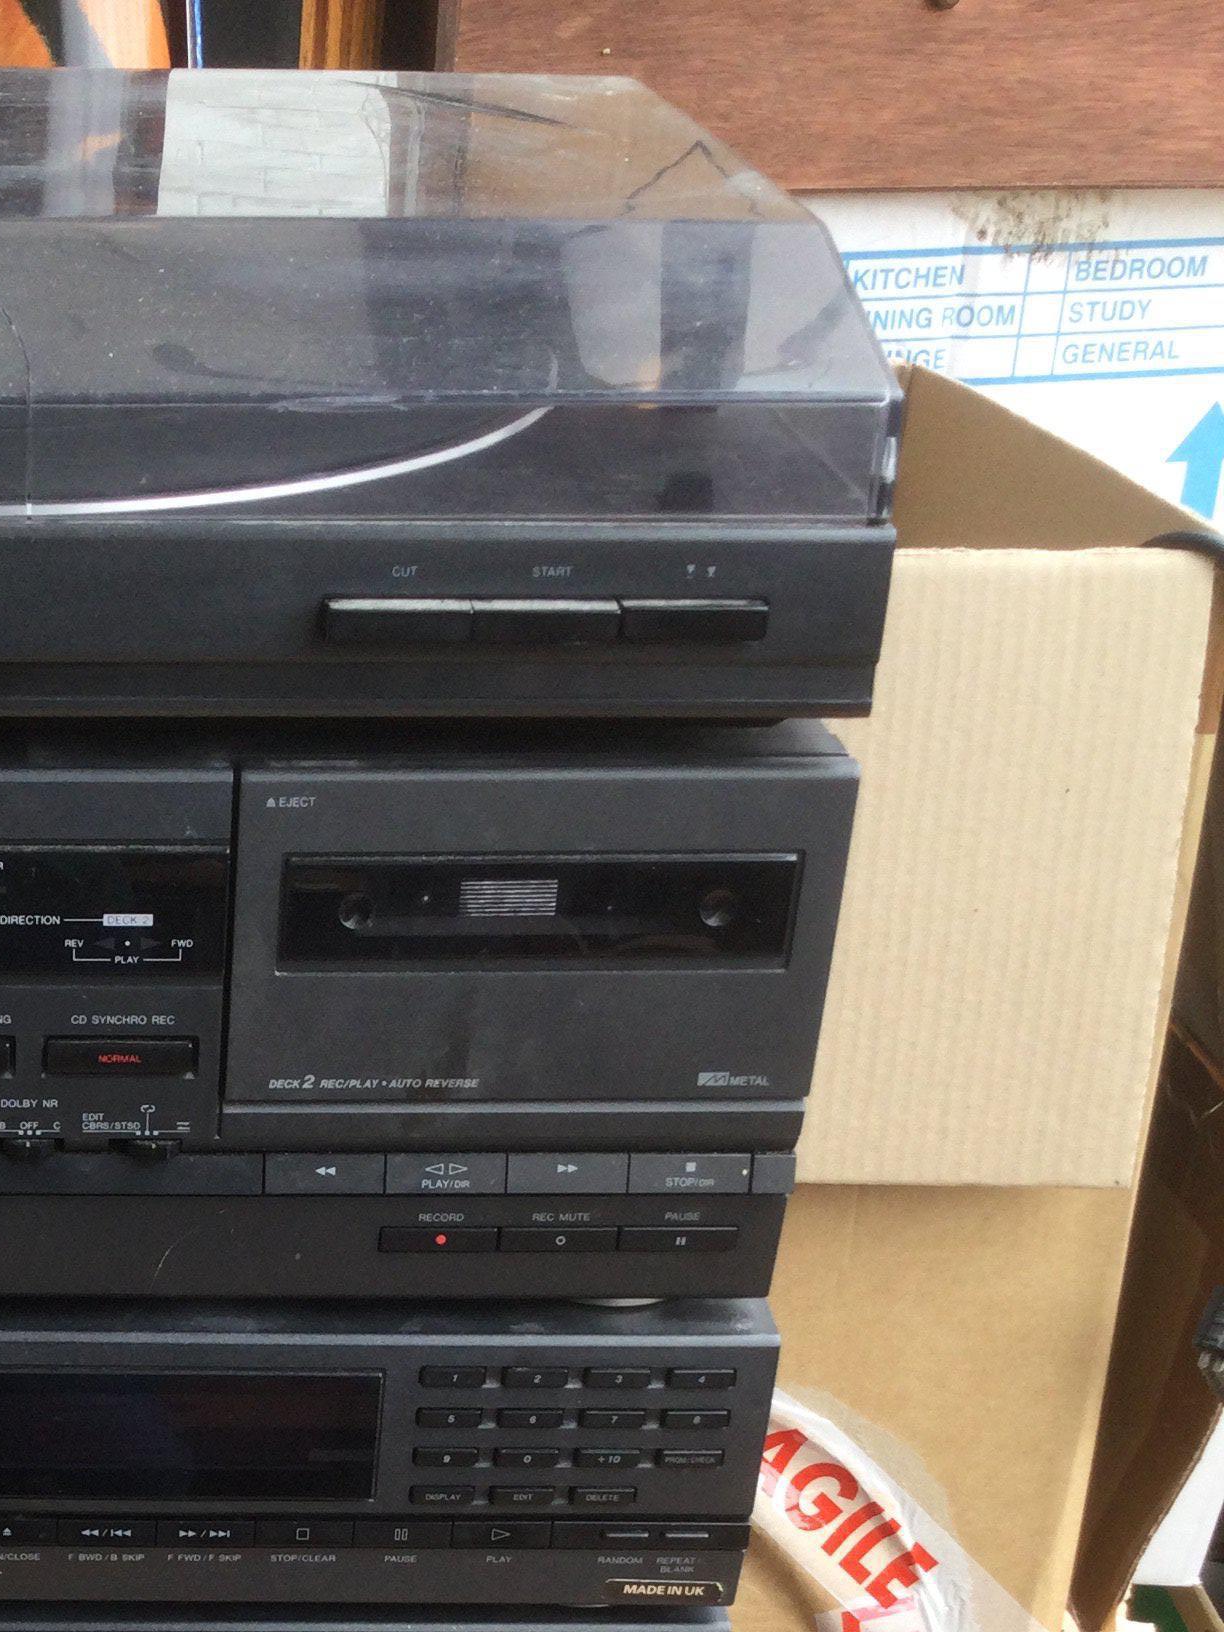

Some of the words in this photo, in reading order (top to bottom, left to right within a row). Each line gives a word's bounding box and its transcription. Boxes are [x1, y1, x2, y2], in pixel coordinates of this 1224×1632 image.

[1075, 254, 1209, 283] BEDROOM
[853, 264, 965, 291] KITCHEN
[941, 305, 1016, 329] ROOM
[1068, 299, 1152, 324] STUDY
[1062, 340, 1181, 365] GENERAL
[532, 565, 573, 578] START
[278, 796, 316, 808] EJECT
[0, 915, 61, 925] DIRECTION
[64, 939, 84, 948] REV
[171, 939, 193, 948] FWD
[114, 955, 139, 965] PLAY
[70, 1015, 87, 1025] CD
[91, 1015, 147, 1025] SYNCHRO
[152, 1015, 175, 1025] REC
[98, 1054, 142, 1063] NORMAL
[320, 1078, 379, 1090] REC/PLAY
[389, 1078, 421, 1088] AUTO
[425, 1077, 479, 1088] REVERSE
[730, 1075, 769, 1086] METAL
[0, 1099, 35, 1108] DOLBY
[41, 1099, 58, 1108] NR
[421, 1178, 470, 1189] PLAY/DIR
[418, 1212, 464, 1222] RECORD
[532, 1212, 555, 1222] REC
[559, 1212, 591, 1222] MUTE
[270, 1554, 337, 1563] STOP/CLEAR
[384, 1554, 417, 1564] PAUSE
[486, 1554, 513, 1564] PLAY
[623, 1583, 665, 1597] MADE
[667, 1583, 681, 1597] IN
[682, 1584, 705, 1597] UK
